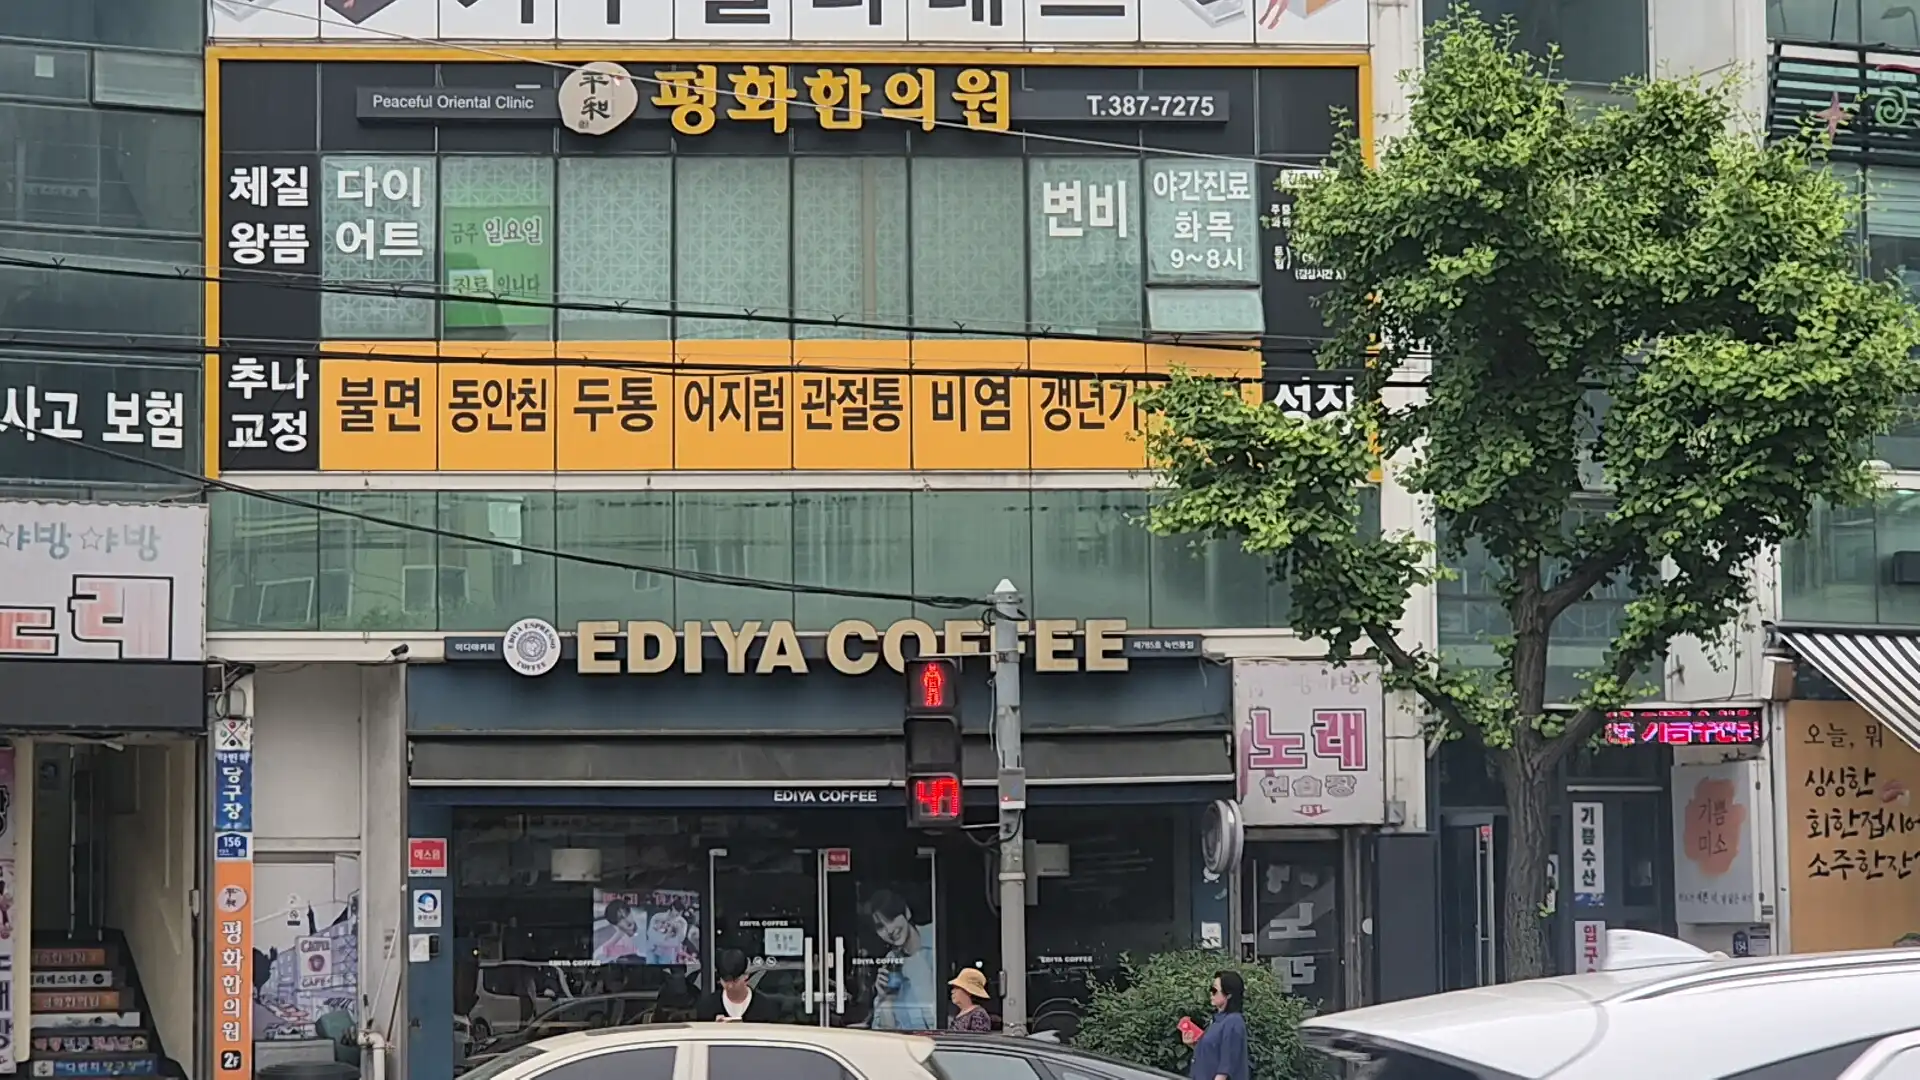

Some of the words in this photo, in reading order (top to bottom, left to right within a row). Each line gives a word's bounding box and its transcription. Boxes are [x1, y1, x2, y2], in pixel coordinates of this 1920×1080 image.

[373, 94, 433, 110] Peaceful
[437, 94, 491, 110] Oriental
[495, 94, 534, 110] Clinic
[650, 64, 1010, 135] 평화한의원
[1086, 95, 1214, 119] T.387-7275
[229, 165, 309, 208] 체질
[337, 165, 422, 208] 다이
[1153, 169, 1251, 202] 야간진료
[450, 220, 479, 246] 금주
[483, 214, 543, 246] 일요일
[1043, 180, 1127, 238] 변비
[228, 221, 309, 264] 왕뜸
[335, 218, 423, 261] 어트
[453, 274, 490, 296] 진료
[228, 357, 309, 400] 추나
[0, 385, 83, 441] 사고
[102, 392, 184, 449] 보험
[336, 377, 421, 433] 불면
[448, 376, 547, 434] 동안침
[573, 377, 657, 433] 두통
[684, 376, 785, 433] 어지럼
[800, 376, 903, 433] 관절통
[931, 376, 1011, 432] 비염
[1041, 377, 1140, 431] 갱년기
[227, 411, 309, 452] 교정
[577, 620, 809, 674] EDIYA
[1248, 706, 1367, 771] 노래
[222, 766, 244, 820] 당구장
[773, 790, 816, 802] EDIYA
[819, 790, 878, 802] COFFEE
[1805, 766, 1876, 798] 싱싱한
[223, 836, 242, 848] 156
[221, 920, 243, 1042] 평화한의원
[223, 1052, 240, 1068] 2F
